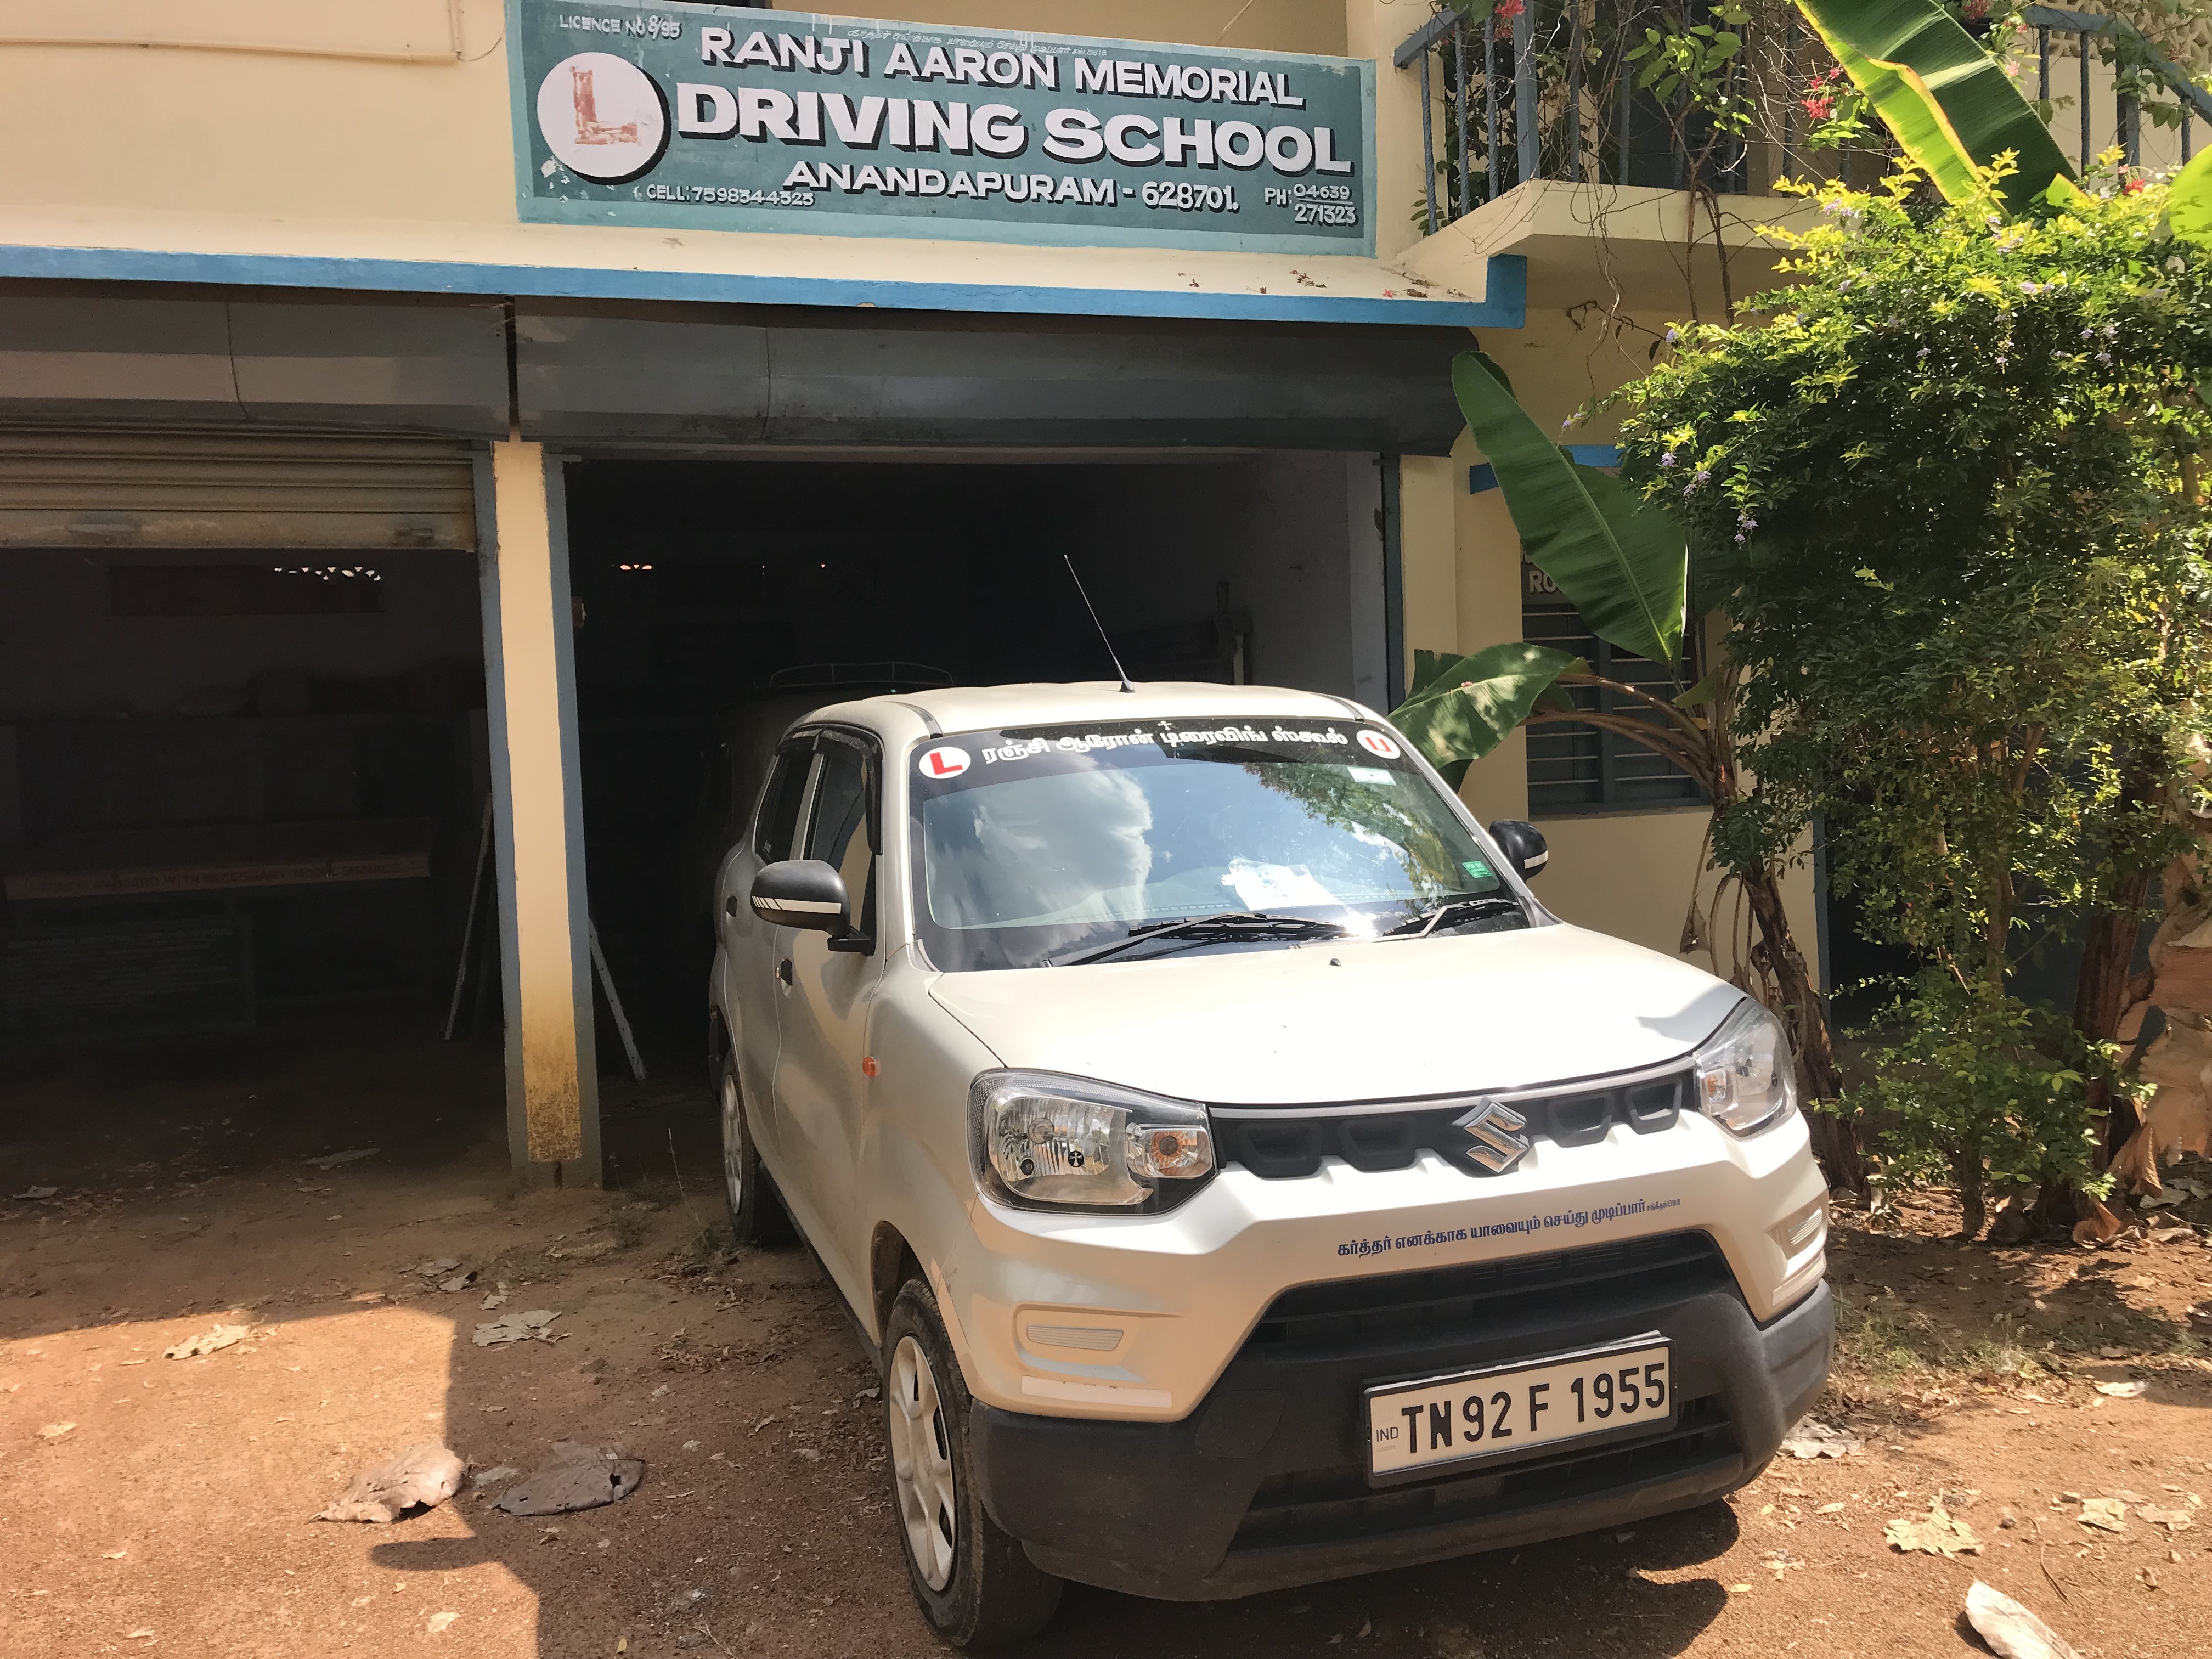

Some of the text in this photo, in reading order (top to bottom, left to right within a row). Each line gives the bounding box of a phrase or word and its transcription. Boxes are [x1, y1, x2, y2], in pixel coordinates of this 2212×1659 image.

[560, 14, 621, 33] LICENCE
[701, 27, 1305, 107] RANJI AARON MEMORIAL
[568, 65, 641, 146] L
[676, 82, 1352, 173] DRIVING SCHOOL
[783, 161, 1115, 205] ANANDAPURAM
[1293, 183, 1350, 200] 04639
[1295, 203, 1356, 224] 271323
[930, 752, 963, 776] L
[982, 738, 1051, 764] ரஞ்சி
[1056, 728, 1155, 753] ஆரோன்
[1337, 1235, 1392, 1259] கர்த்தர்
[1395, 1229, 1468, 1250] எனக்காக
[1471, 1215, 1540, 1239] யாவையும்
[1544, 1209, 1589, 1228] செய்து
[1592, 1198, 1646, 1224] முடிப்பார்
[1401, 1362, 1665, 1454] TN 92 F 1955
[1376, 1426, 1399, 1442] IND
